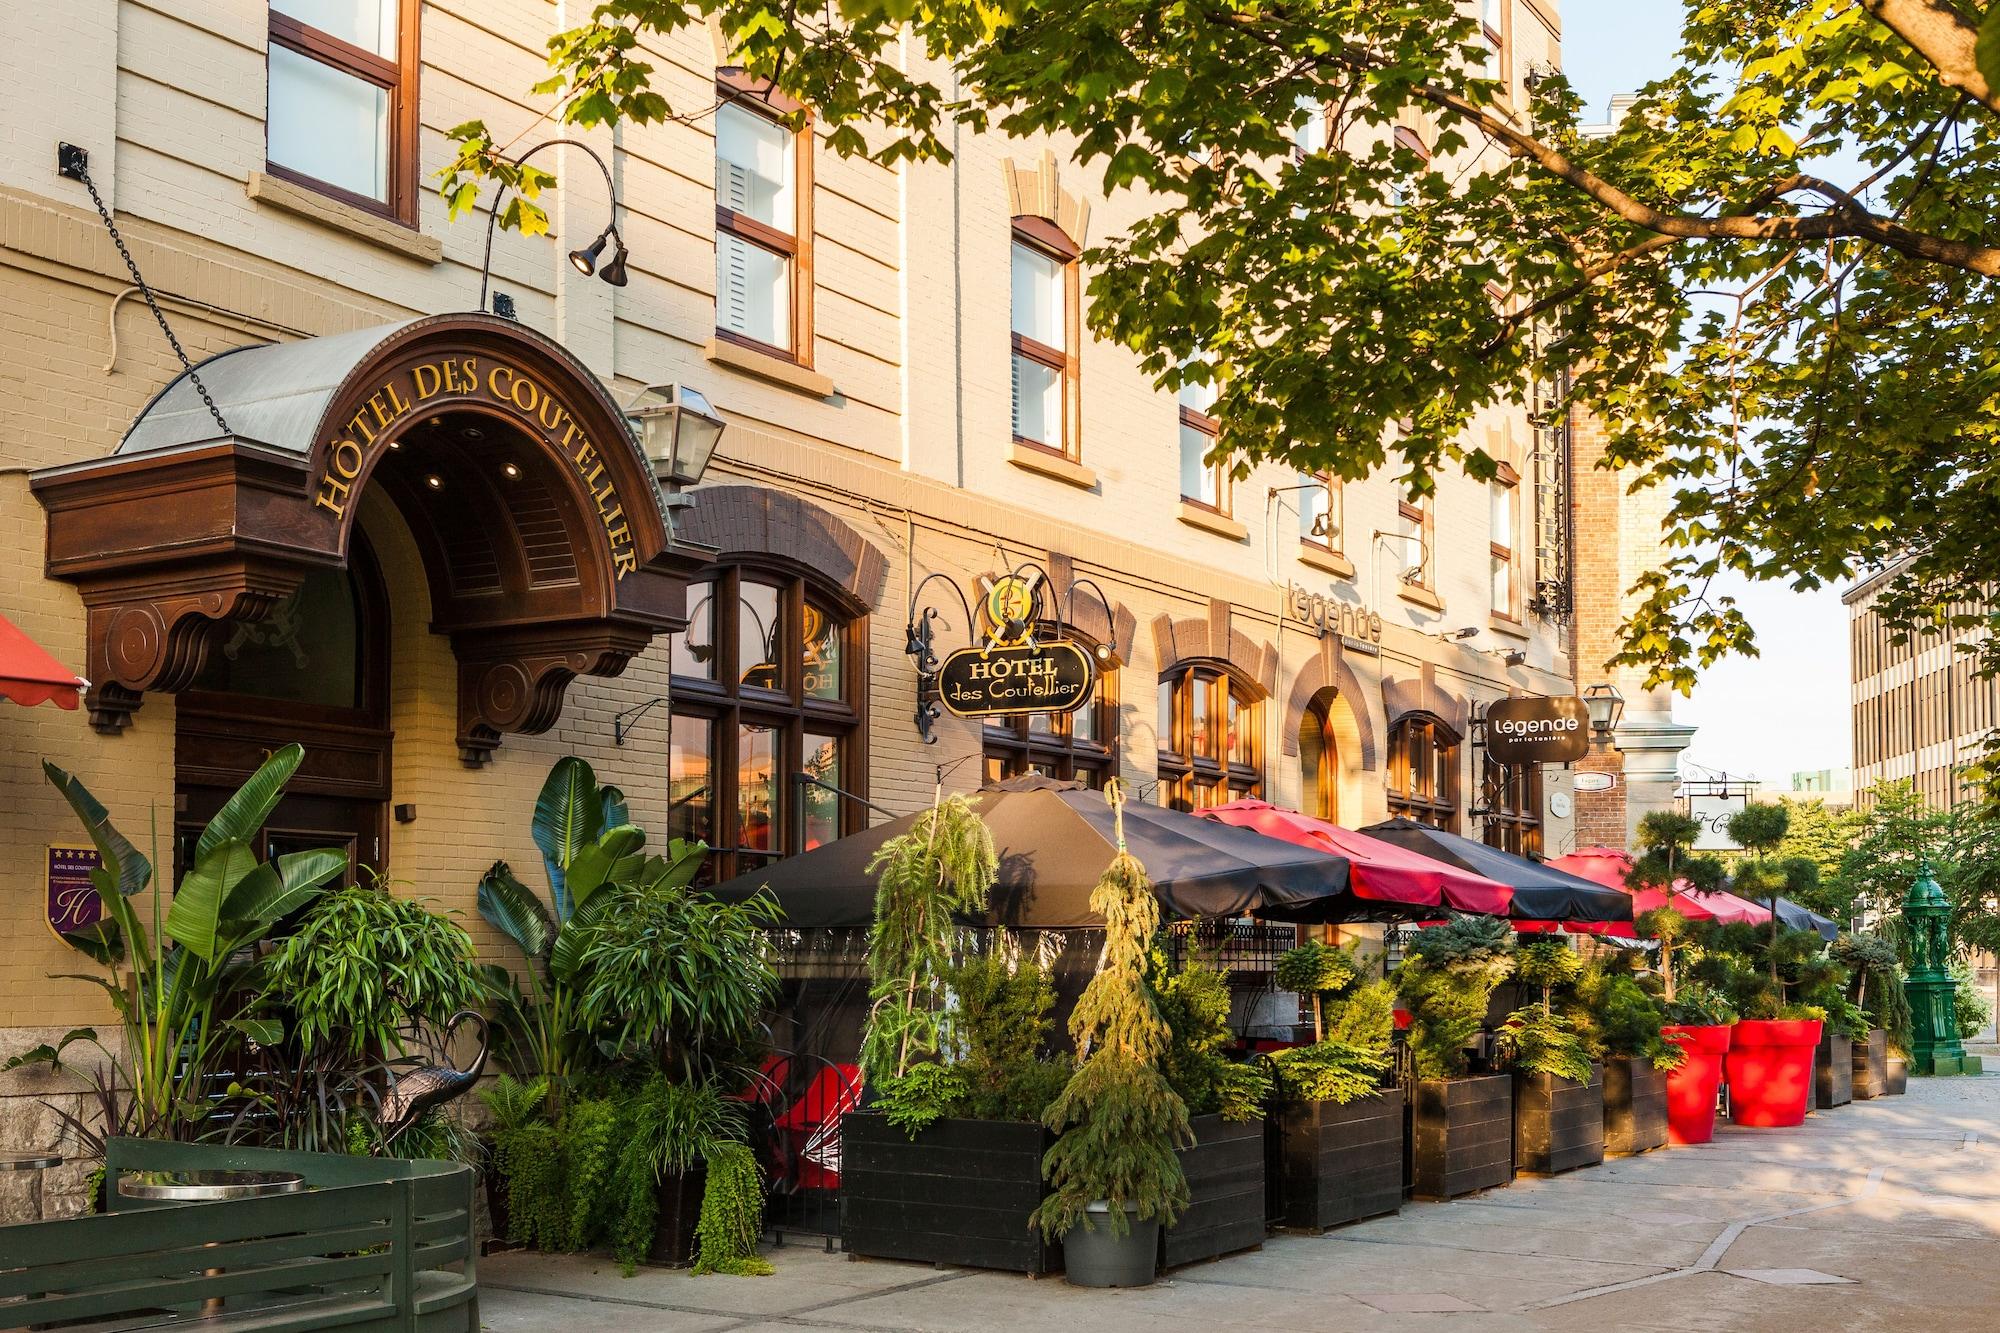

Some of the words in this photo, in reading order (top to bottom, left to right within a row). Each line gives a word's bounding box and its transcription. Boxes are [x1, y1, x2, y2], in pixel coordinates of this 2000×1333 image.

[315, 380, 413, 521] HÔTEL
[411, 355, 480, 401] DES
[487, 366, 638, 582] COUTELLIER
[968, 657, 1059, 681] HÔTEL
[949, 682, 983, 701] des
[988, 673, 1080, 699] Coutellier
[51, 887, 98, 925] H
